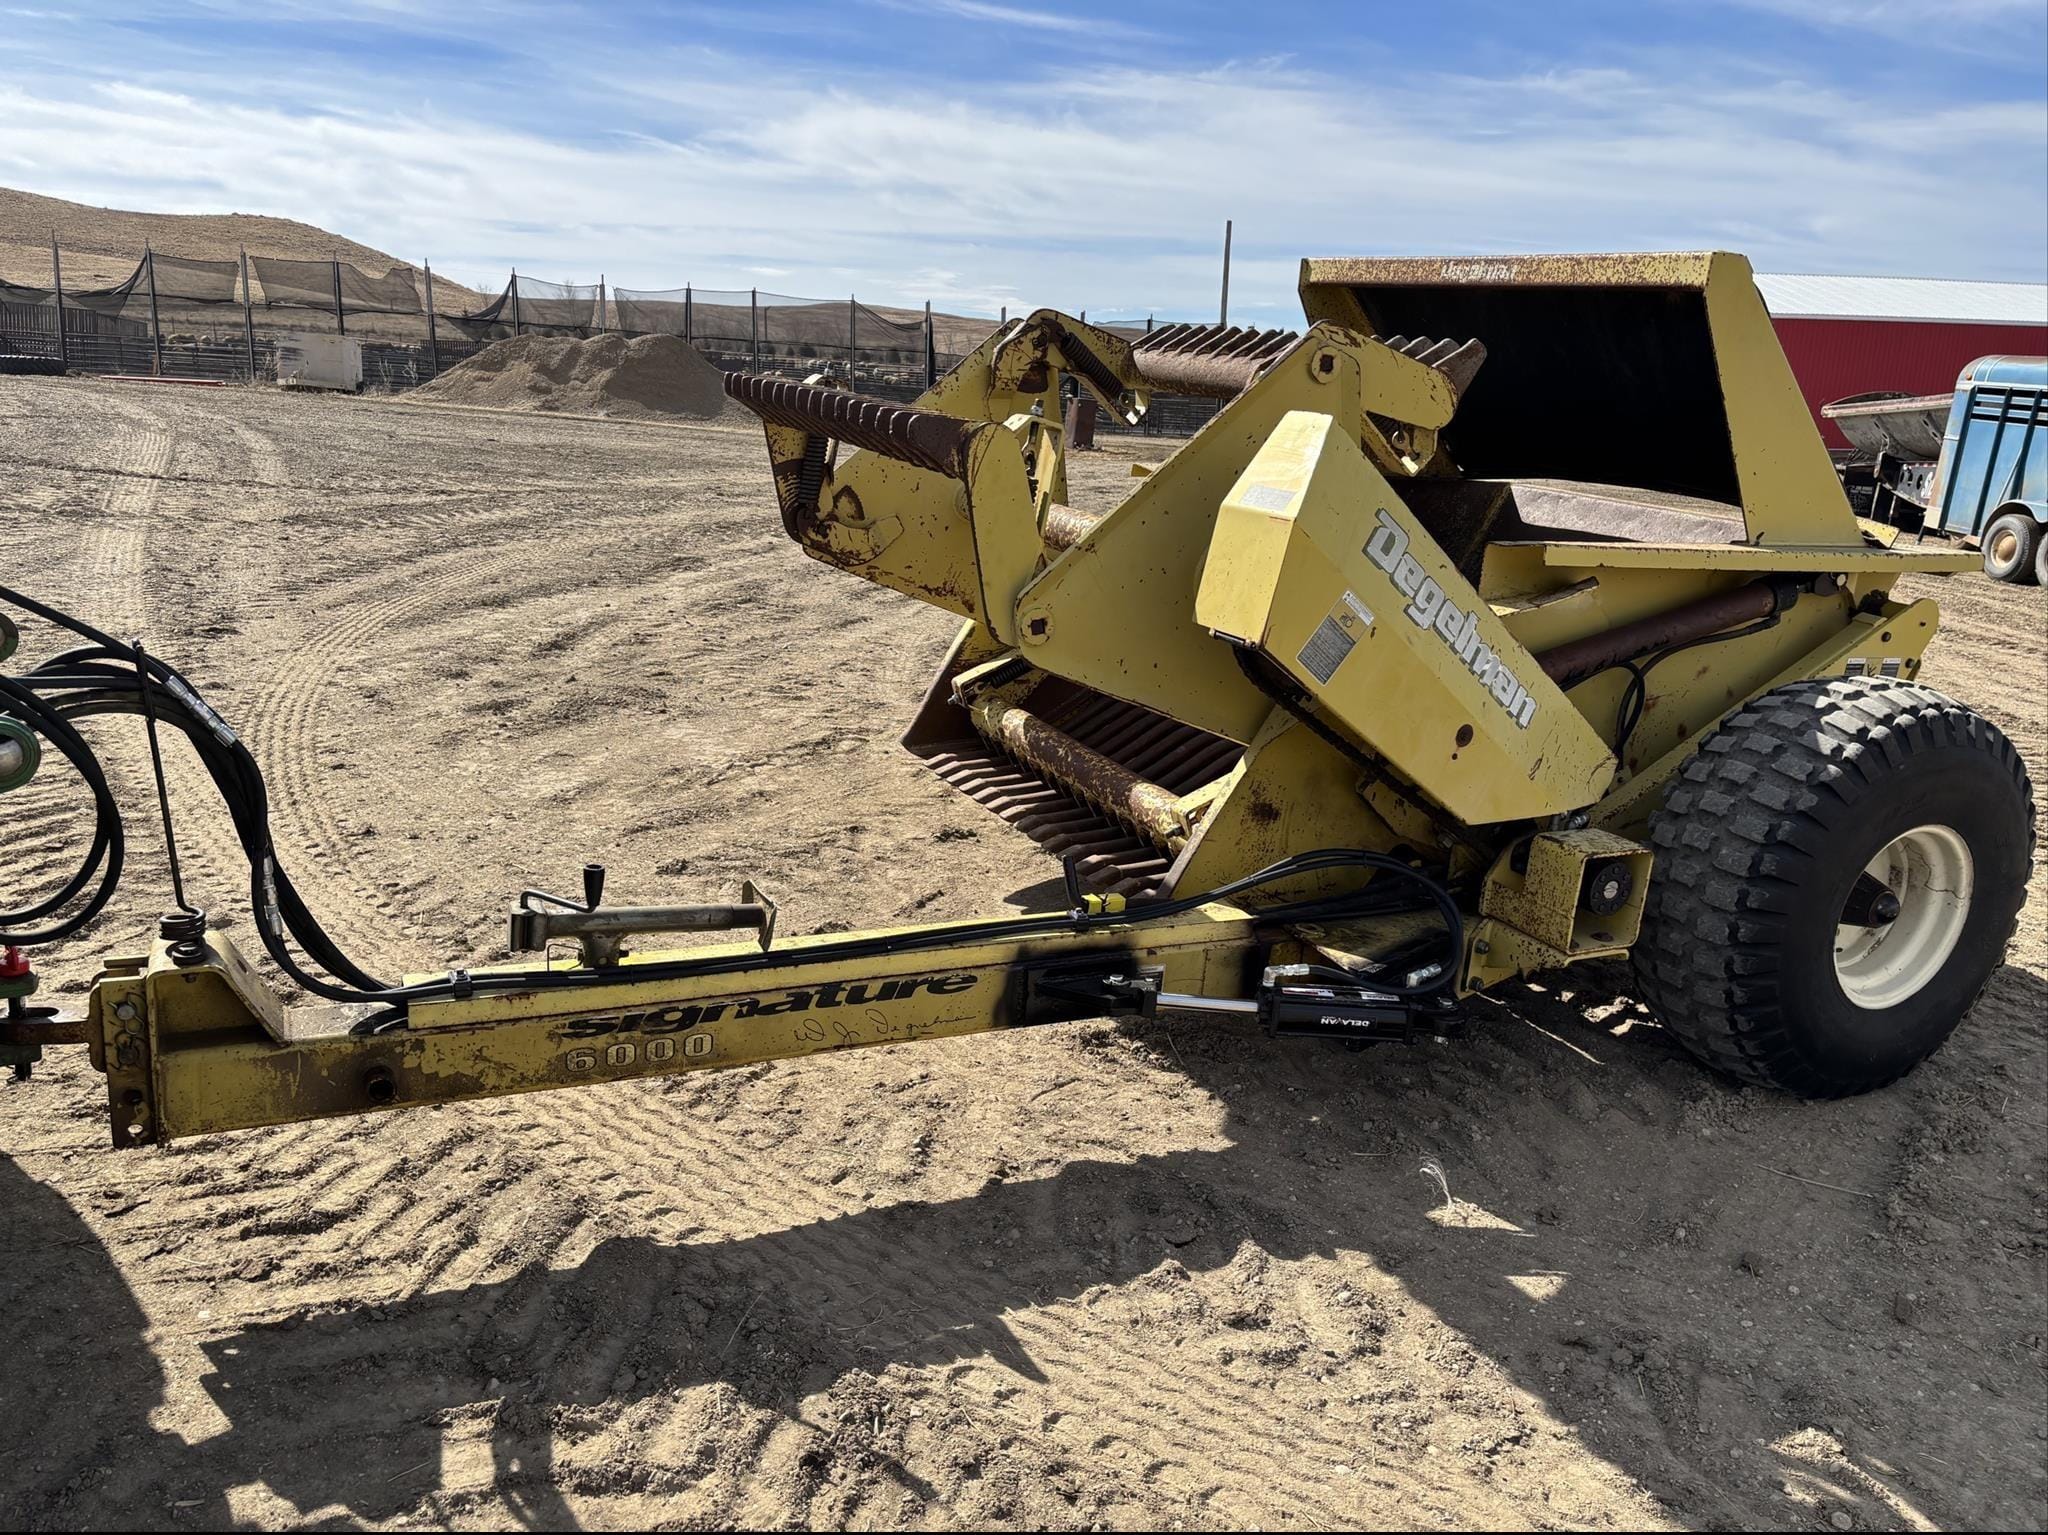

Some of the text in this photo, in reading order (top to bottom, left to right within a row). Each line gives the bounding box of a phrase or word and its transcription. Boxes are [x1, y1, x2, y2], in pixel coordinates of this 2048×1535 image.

[1362, 508, 1537, 729] Degelman
[562, 972, 979, 1036] signature
[565, 1033, 714, 1073] 6000
